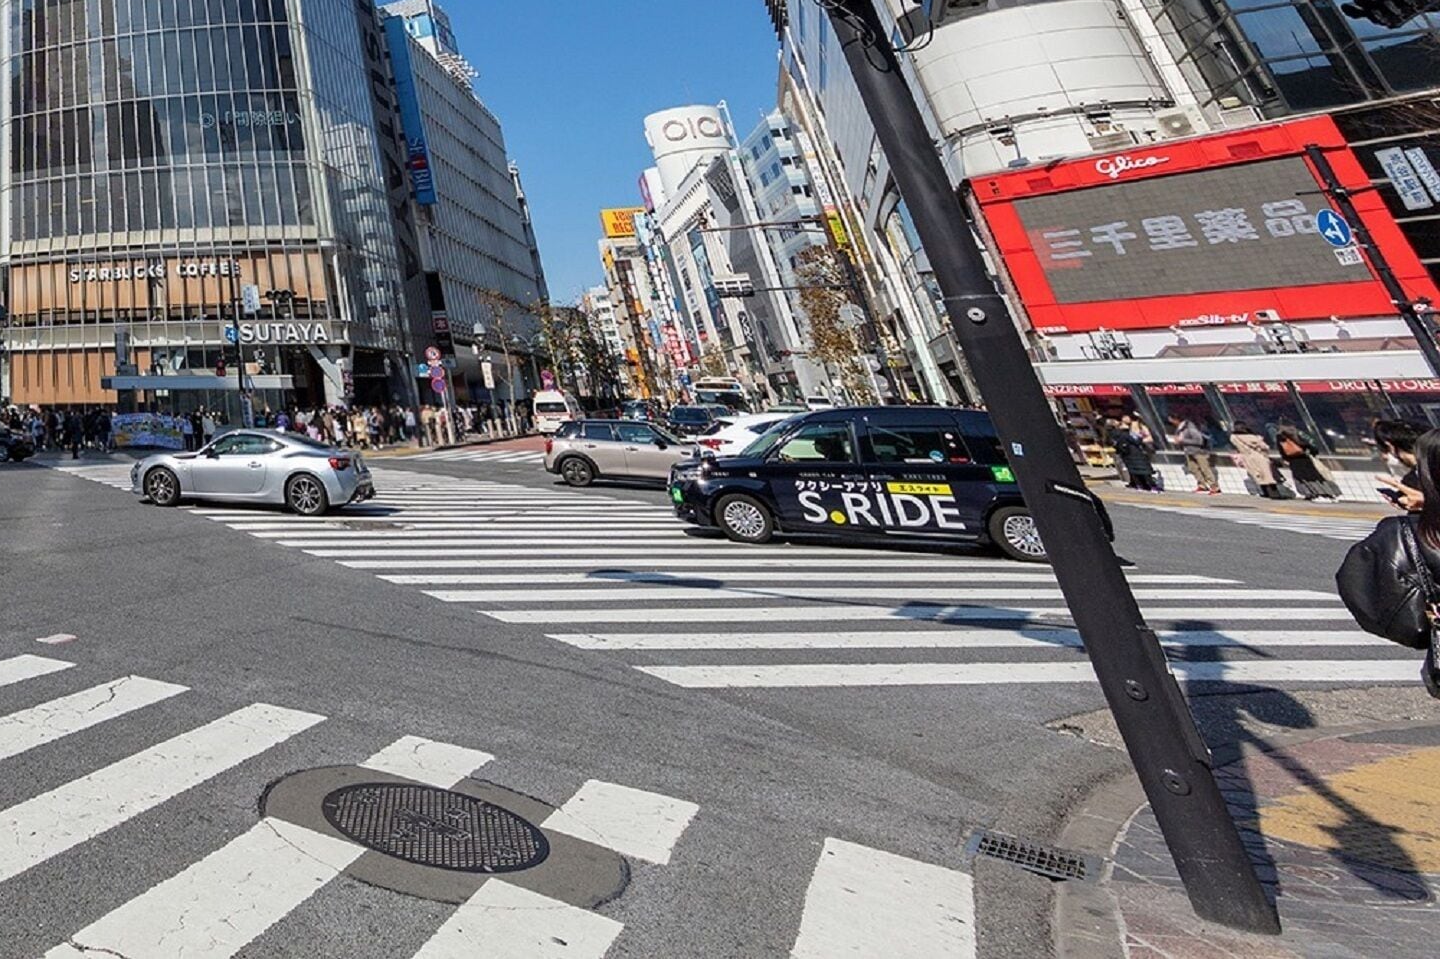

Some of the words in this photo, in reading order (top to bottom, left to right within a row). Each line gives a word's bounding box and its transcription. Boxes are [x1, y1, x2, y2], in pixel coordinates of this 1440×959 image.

[1095, 154, 1169, 178] Glico
[1042, 198, 1319, 260] 三千里薬品
[70, 263, 165, 283] STARBUCKS
[175, 260, 242, 277] COFFEE
[236, 322, 329, 343] SUTAYA
[1042, 385, 1094, 394] ANZENRI
[794, 479, 883, 493] タクシーアプリ
